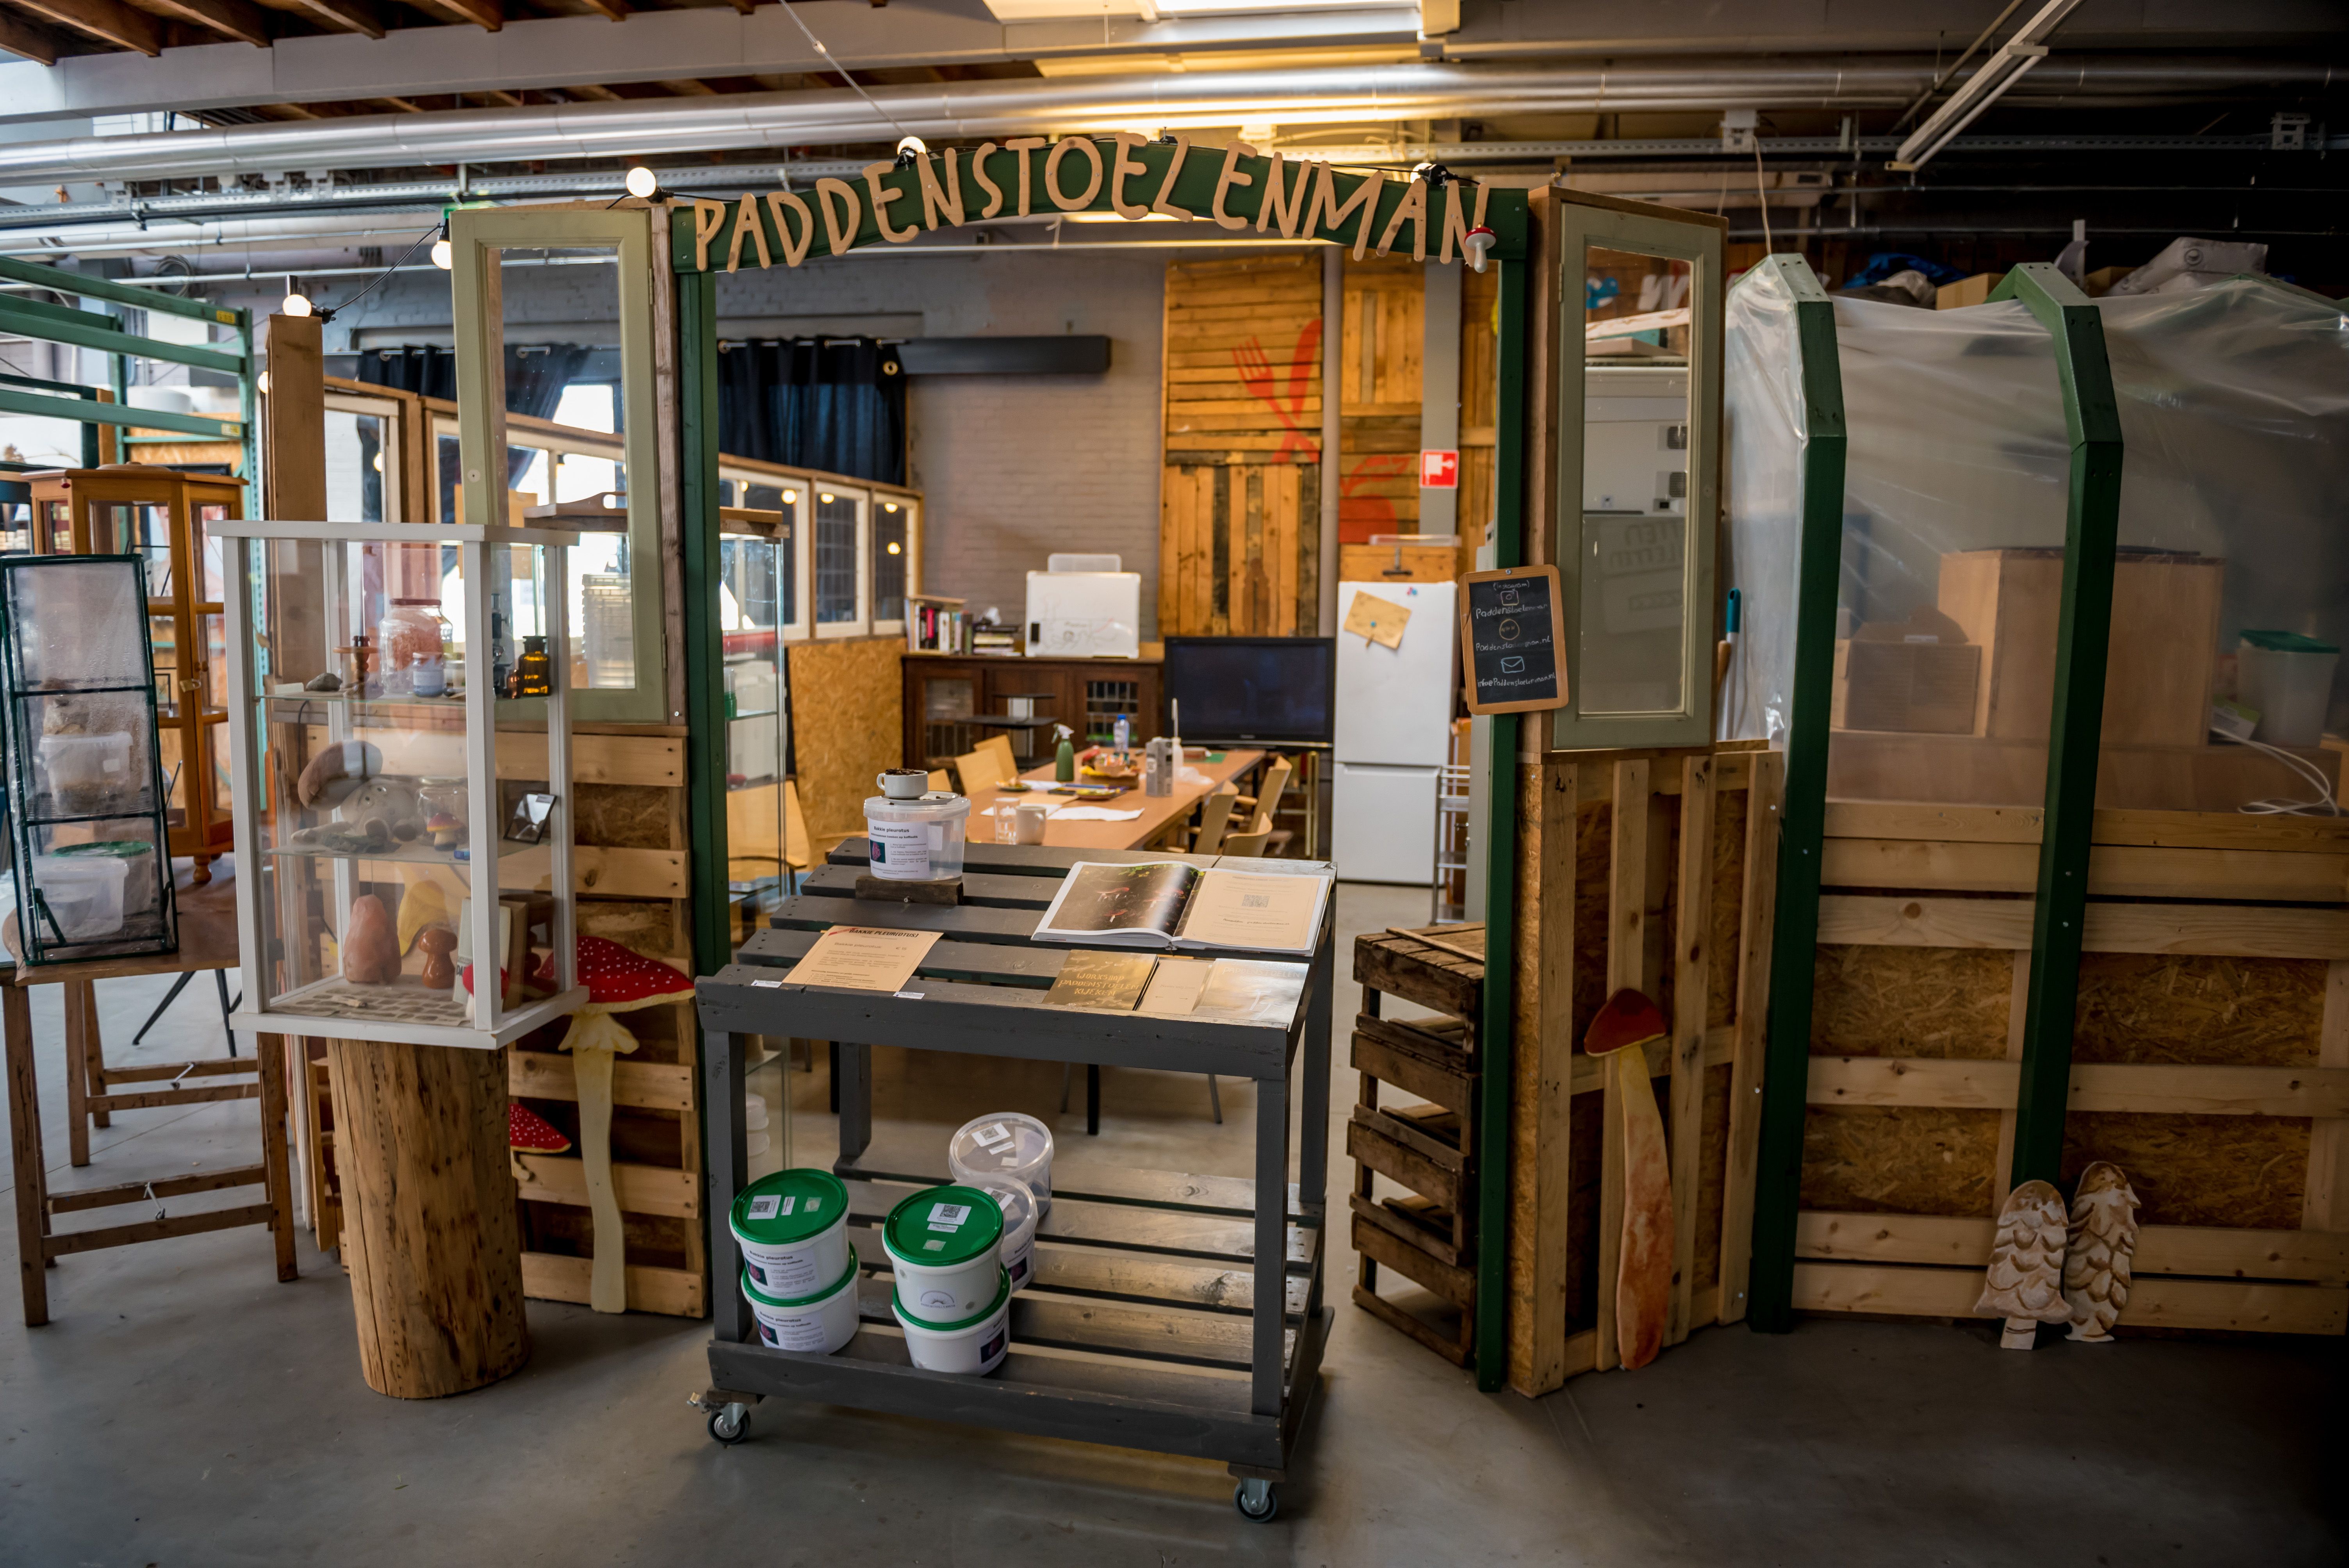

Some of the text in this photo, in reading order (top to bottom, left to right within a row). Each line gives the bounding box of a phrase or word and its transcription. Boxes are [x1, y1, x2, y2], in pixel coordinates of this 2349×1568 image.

[695, 132, 1491, 273] PADDENSTOELENMAN
[1476, 604, 1547, 618] Paddenstoelenan
[1058, 979, 1139, 990] PADDENSTOELEN
